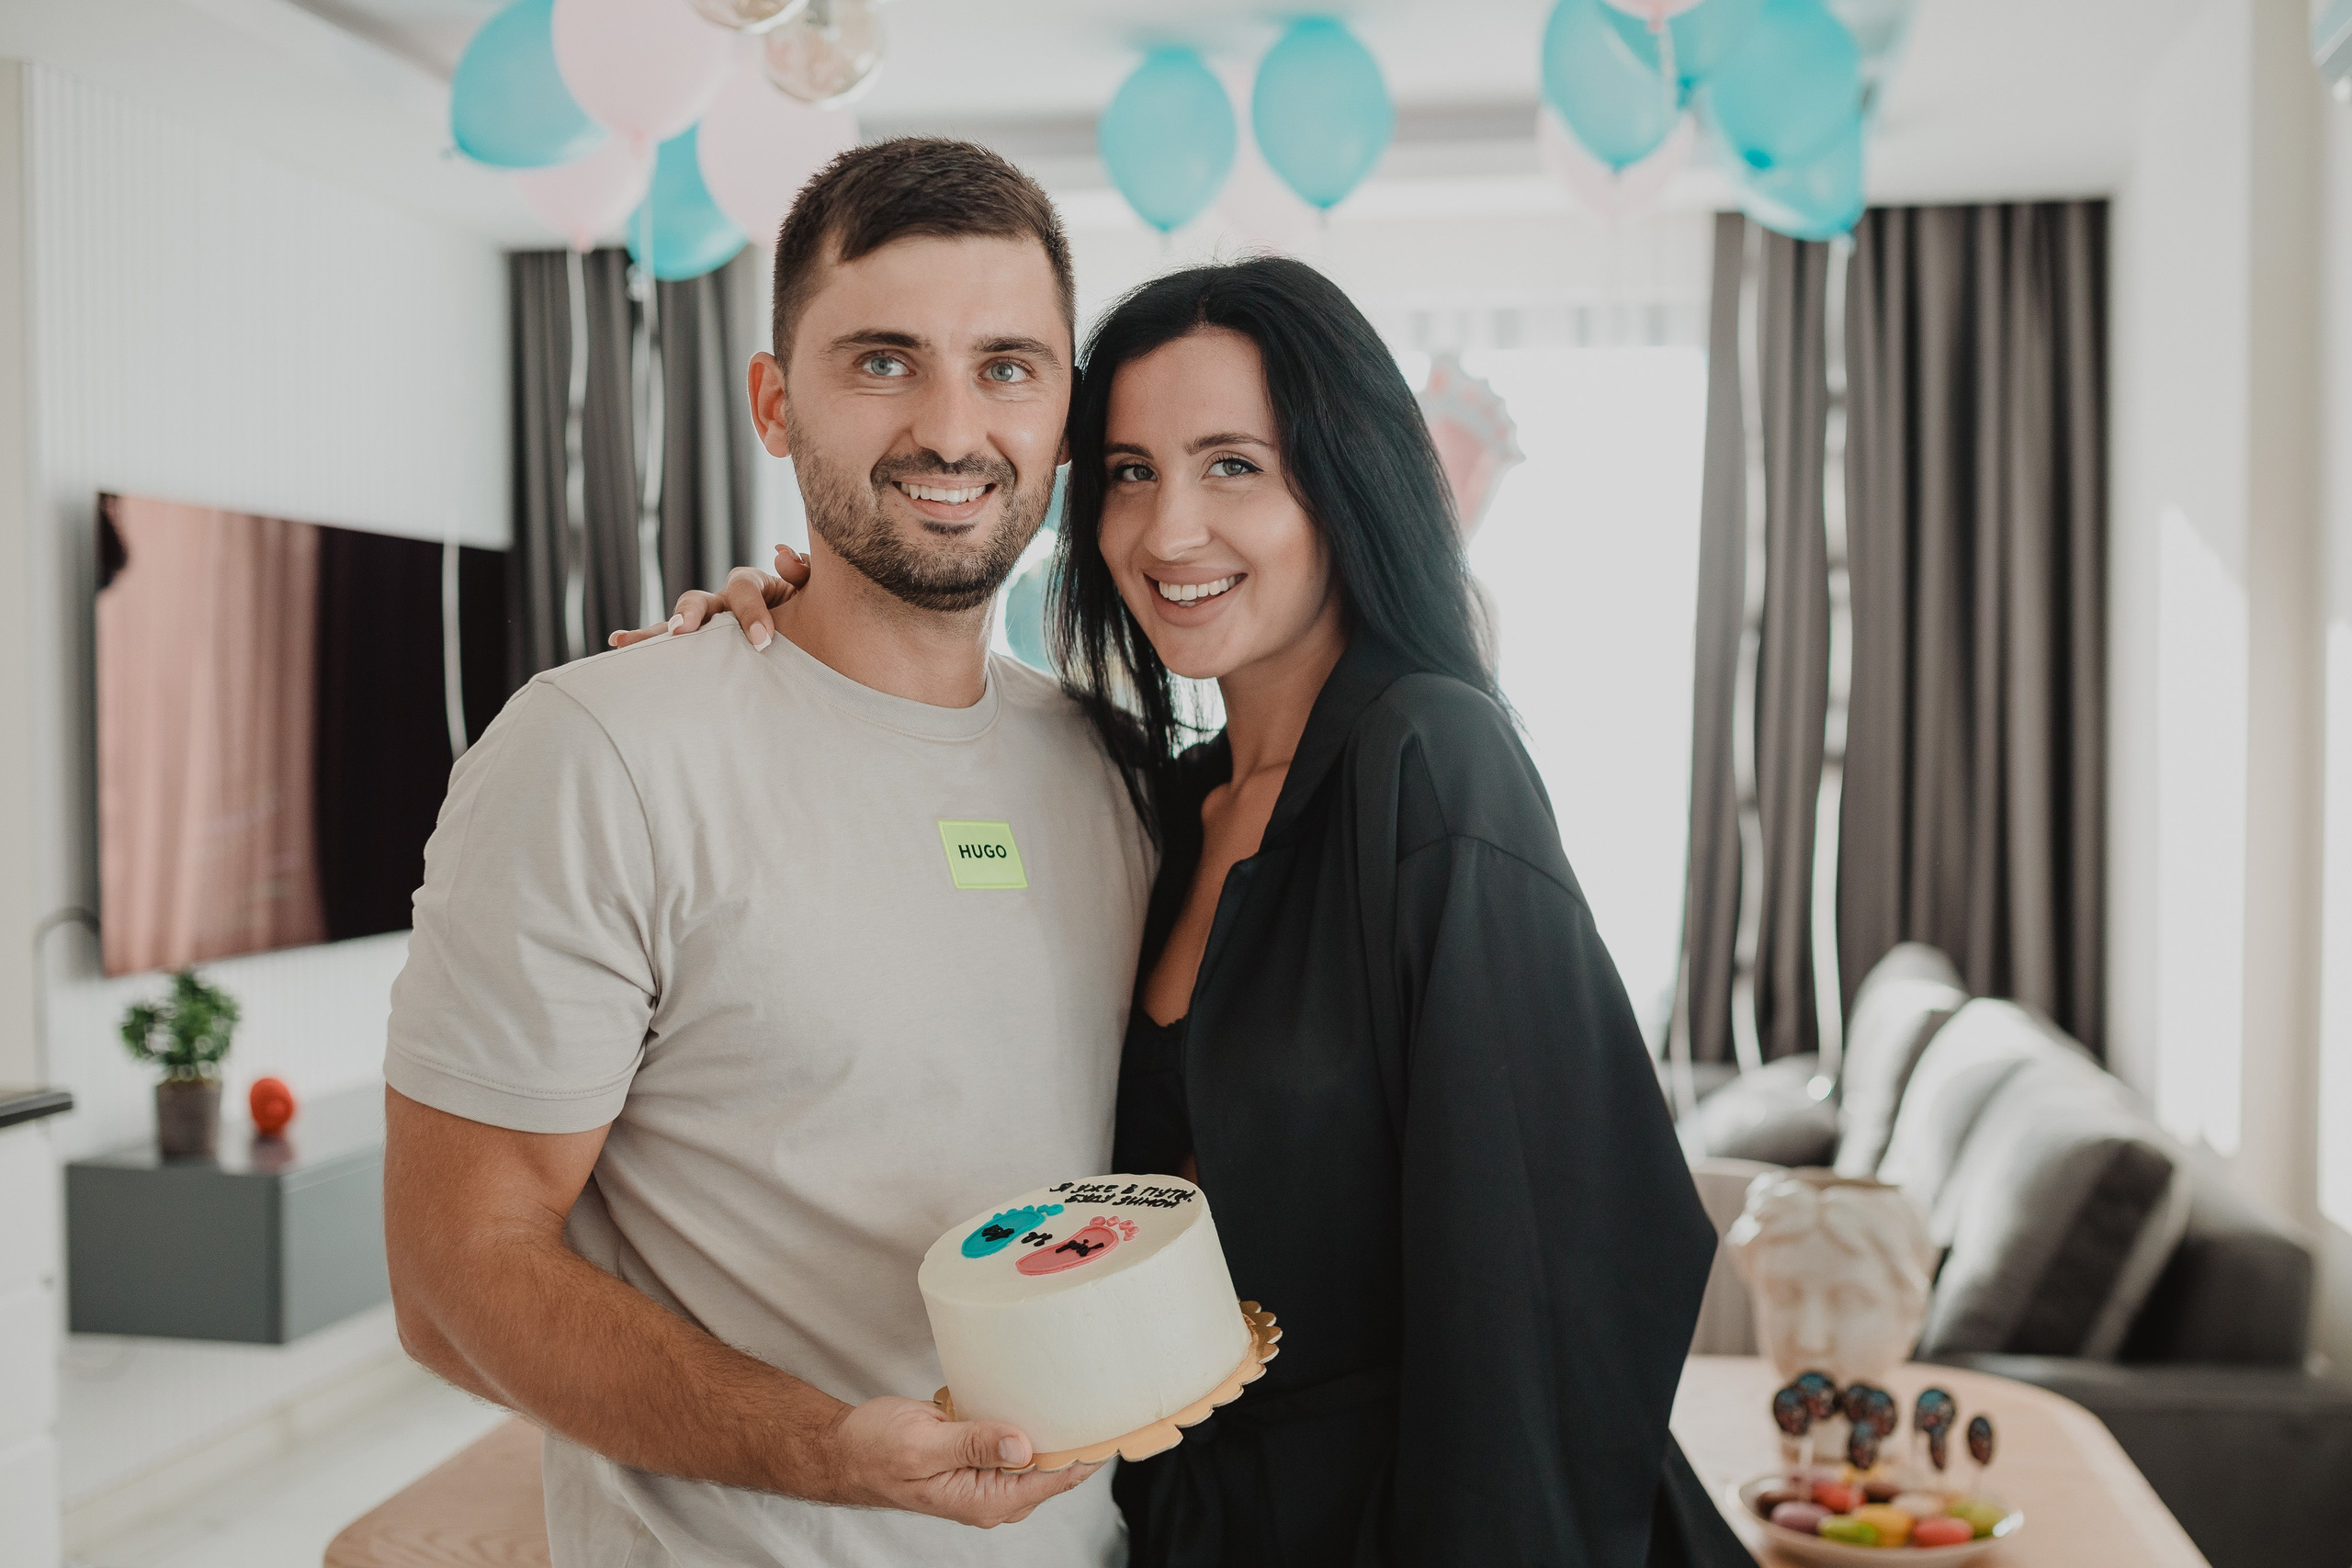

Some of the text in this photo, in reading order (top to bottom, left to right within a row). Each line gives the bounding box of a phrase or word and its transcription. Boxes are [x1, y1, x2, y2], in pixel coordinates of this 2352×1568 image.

[958, 844, 1007, 859] HUGO
[1049, 1181, 1075, 1192] Я
[1070, 1183, 1119, 1193] УЖЕ
